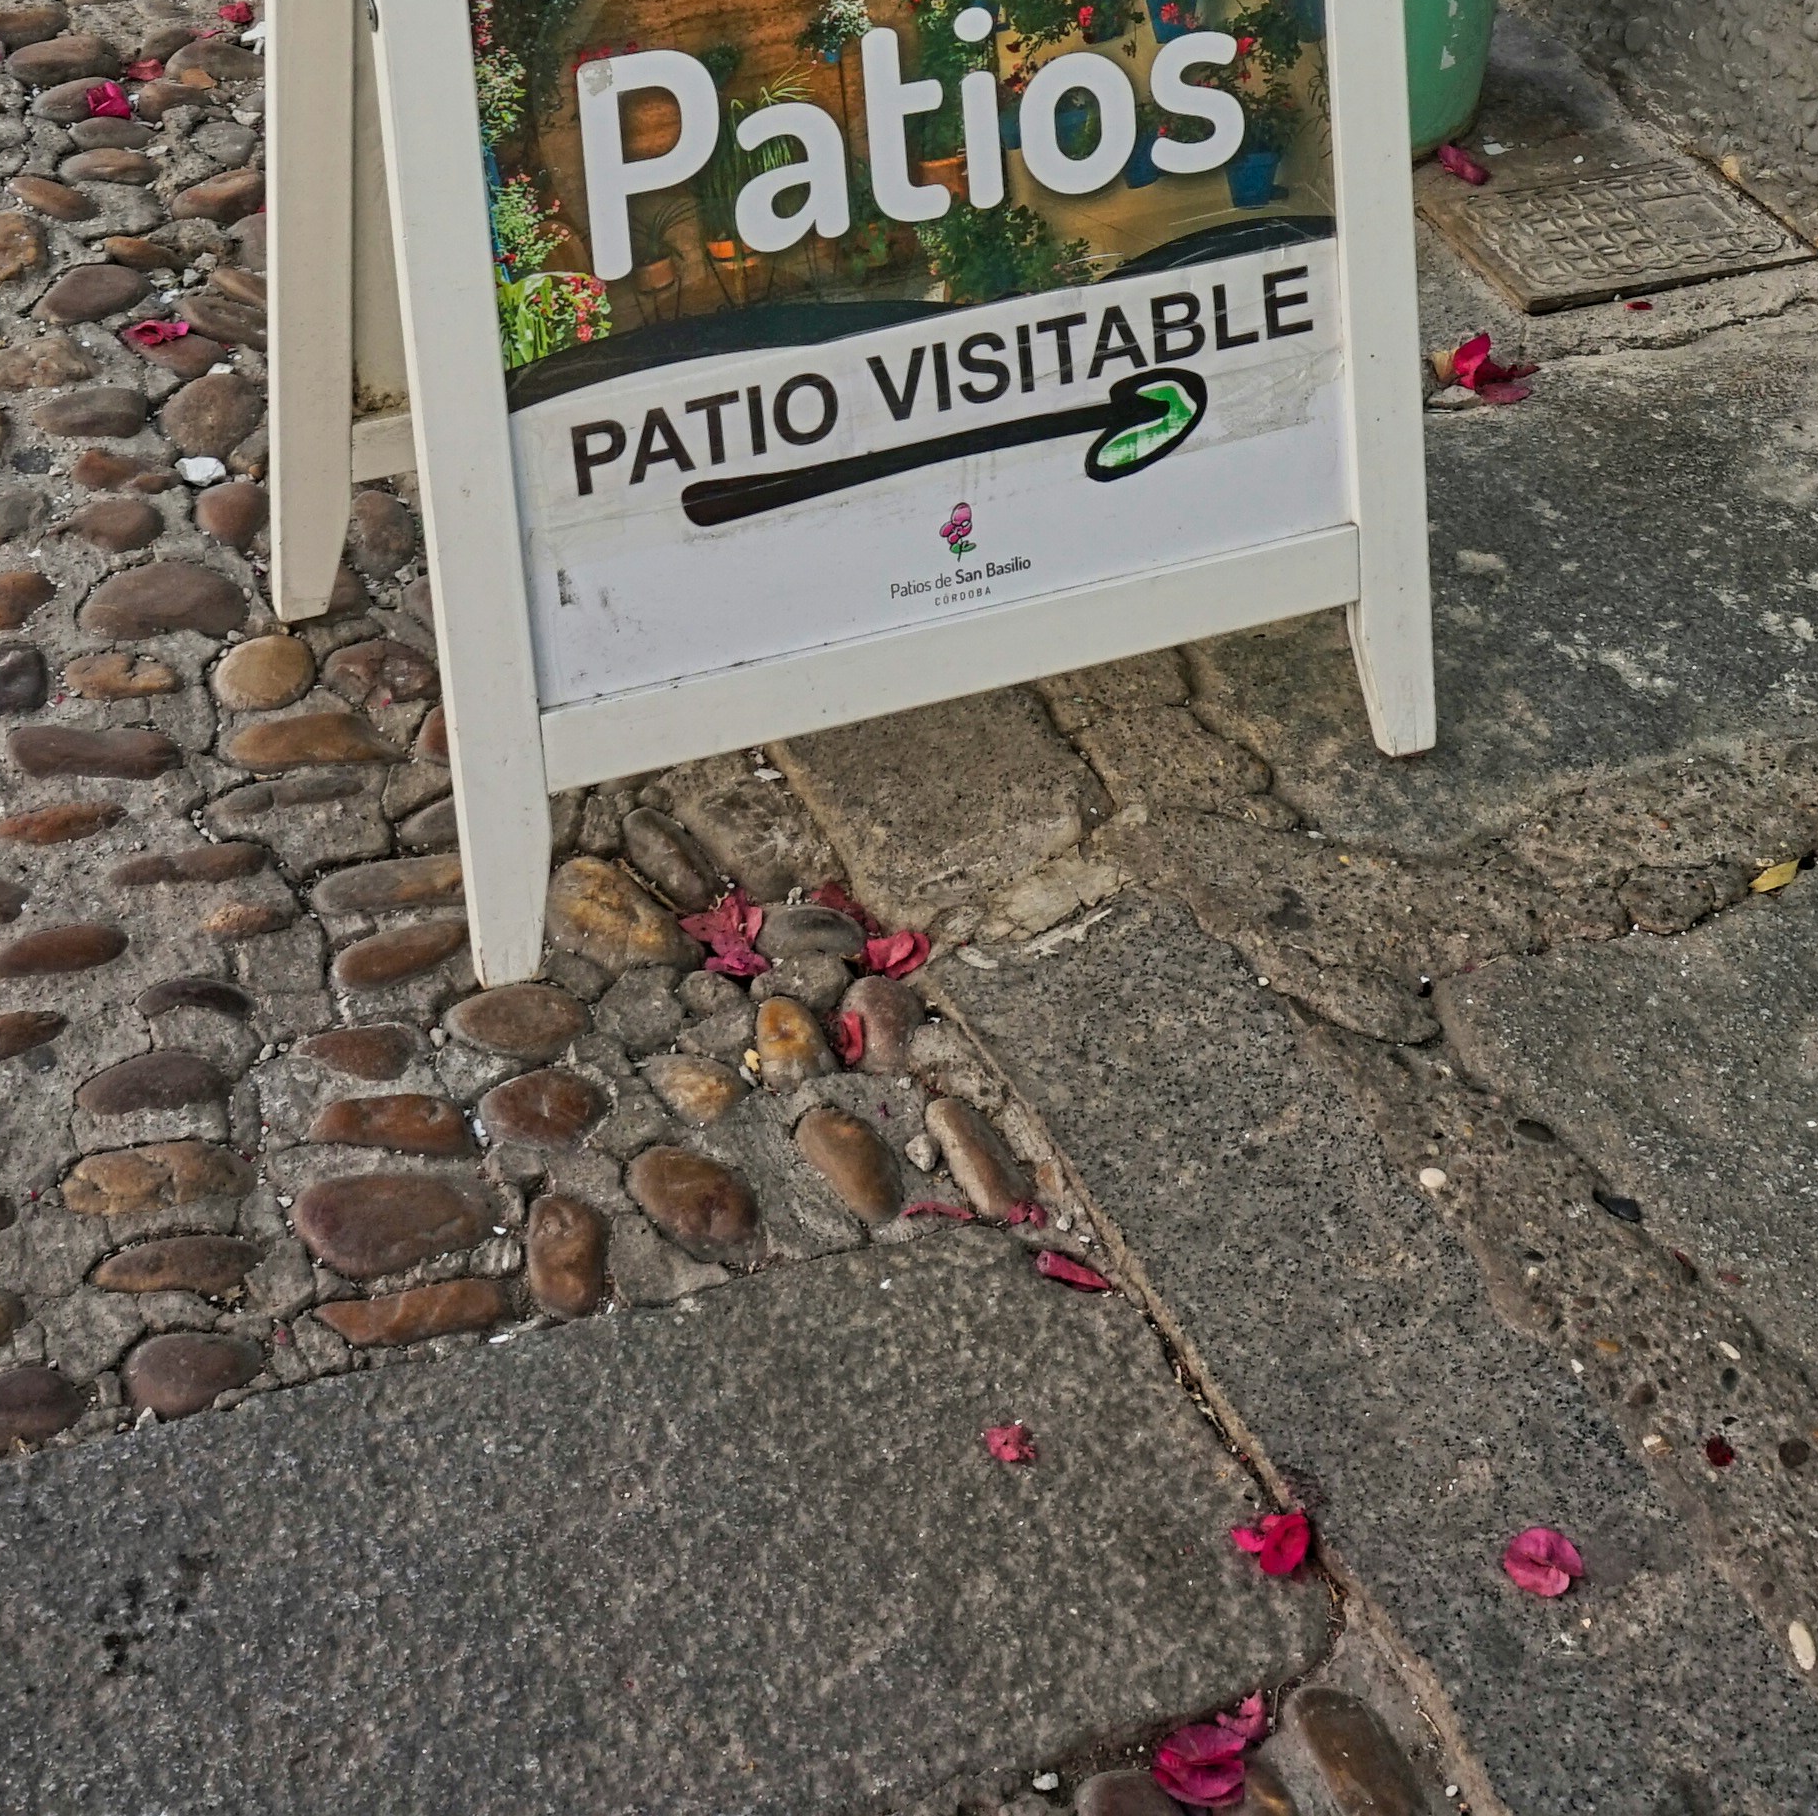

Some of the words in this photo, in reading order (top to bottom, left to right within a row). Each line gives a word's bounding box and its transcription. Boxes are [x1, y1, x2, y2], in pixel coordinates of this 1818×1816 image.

[575, 6, 1245, 282] Patios
[570, 371, 839, 497] PATIO
[866, 265, 1314, 422] VISITABLE
[890, 579, 932, 600] Patios
[935, 572, 952, 590] de
[955, 568, 983, 585] San
[986, 556, 1032, 579] Basilio
